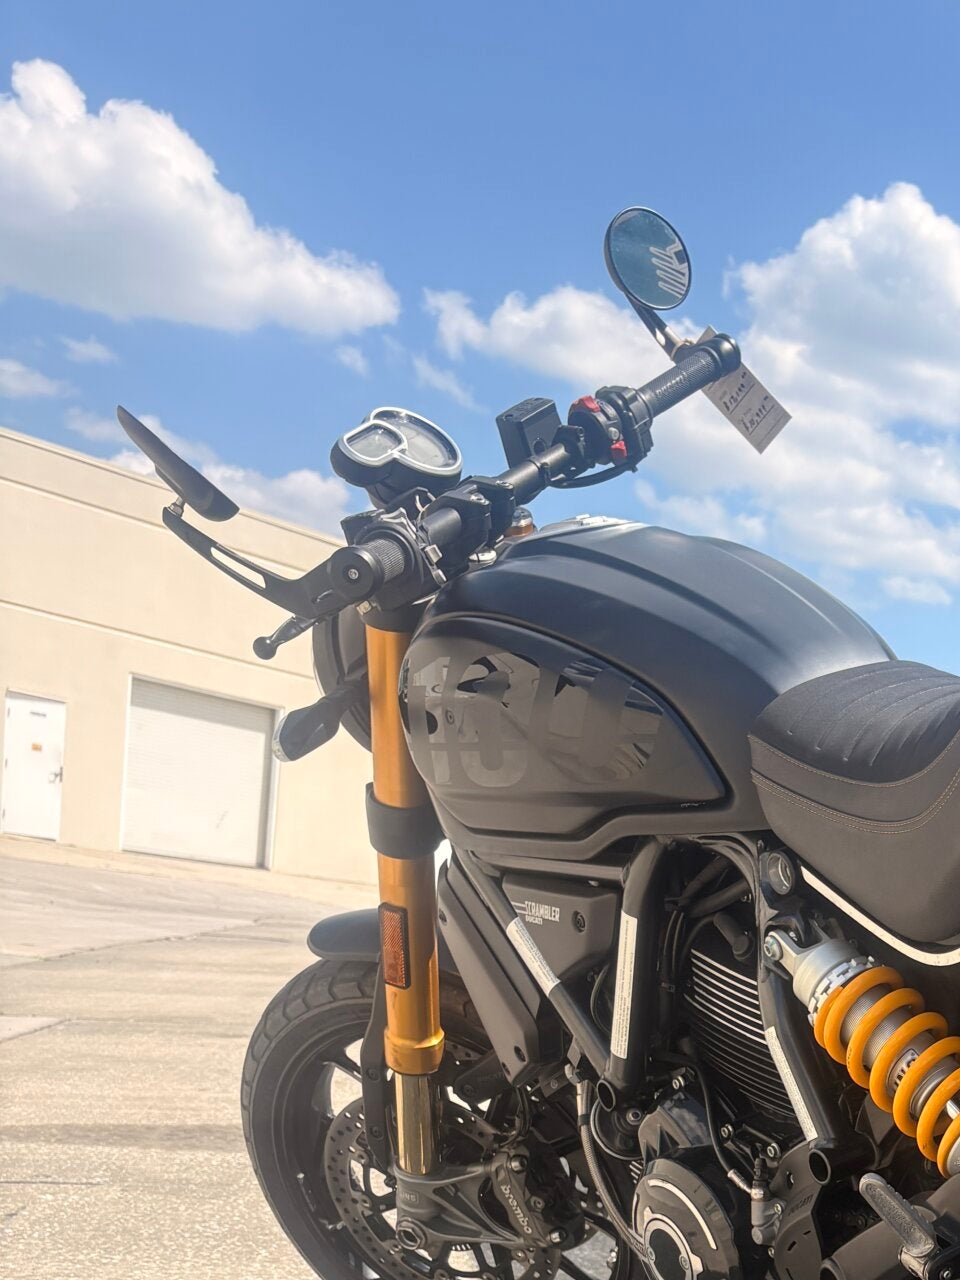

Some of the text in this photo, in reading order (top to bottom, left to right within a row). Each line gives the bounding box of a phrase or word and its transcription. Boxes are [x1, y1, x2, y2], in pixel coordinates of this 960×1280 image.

[525, 900, 560, 922] SCRAMBLER
[525, 914, 543, 926] DUCATI
[501, 1184, 532, 1234] brembo
